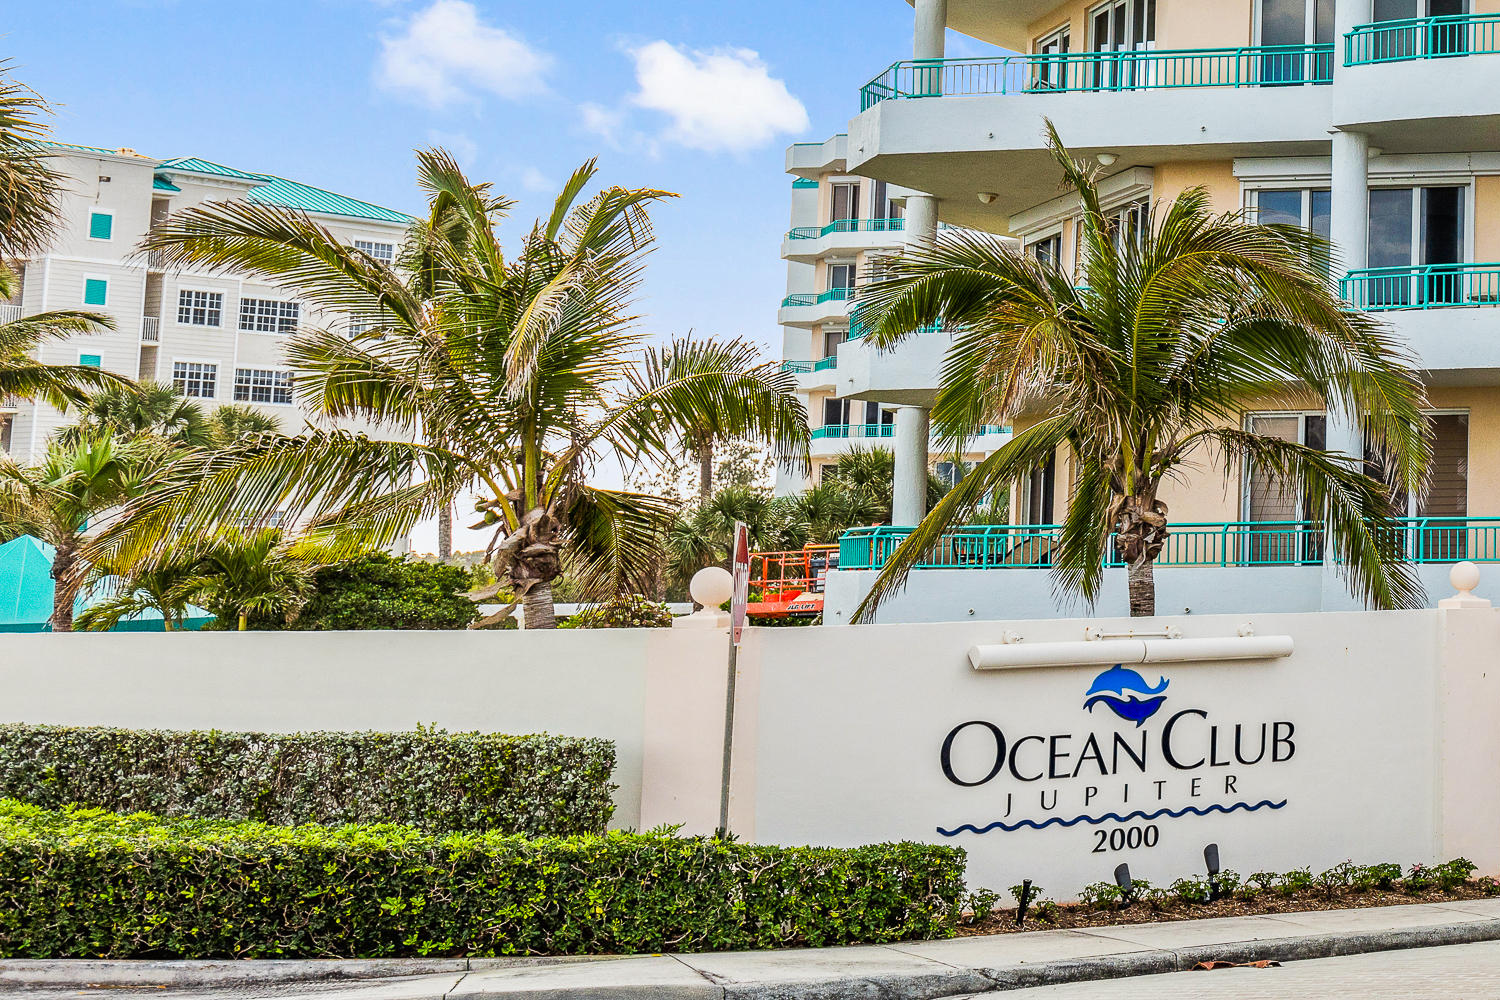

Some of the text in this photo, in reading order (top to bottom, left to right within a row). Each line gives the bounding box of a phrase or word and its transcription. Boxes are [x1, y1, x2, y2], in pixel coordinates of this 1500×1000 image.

[940, 708, 1297, 787] OCEAN CLUB
[1004, 774, 1238, 818] JUPITER
[1091, 824, 1160, 853] 2000
